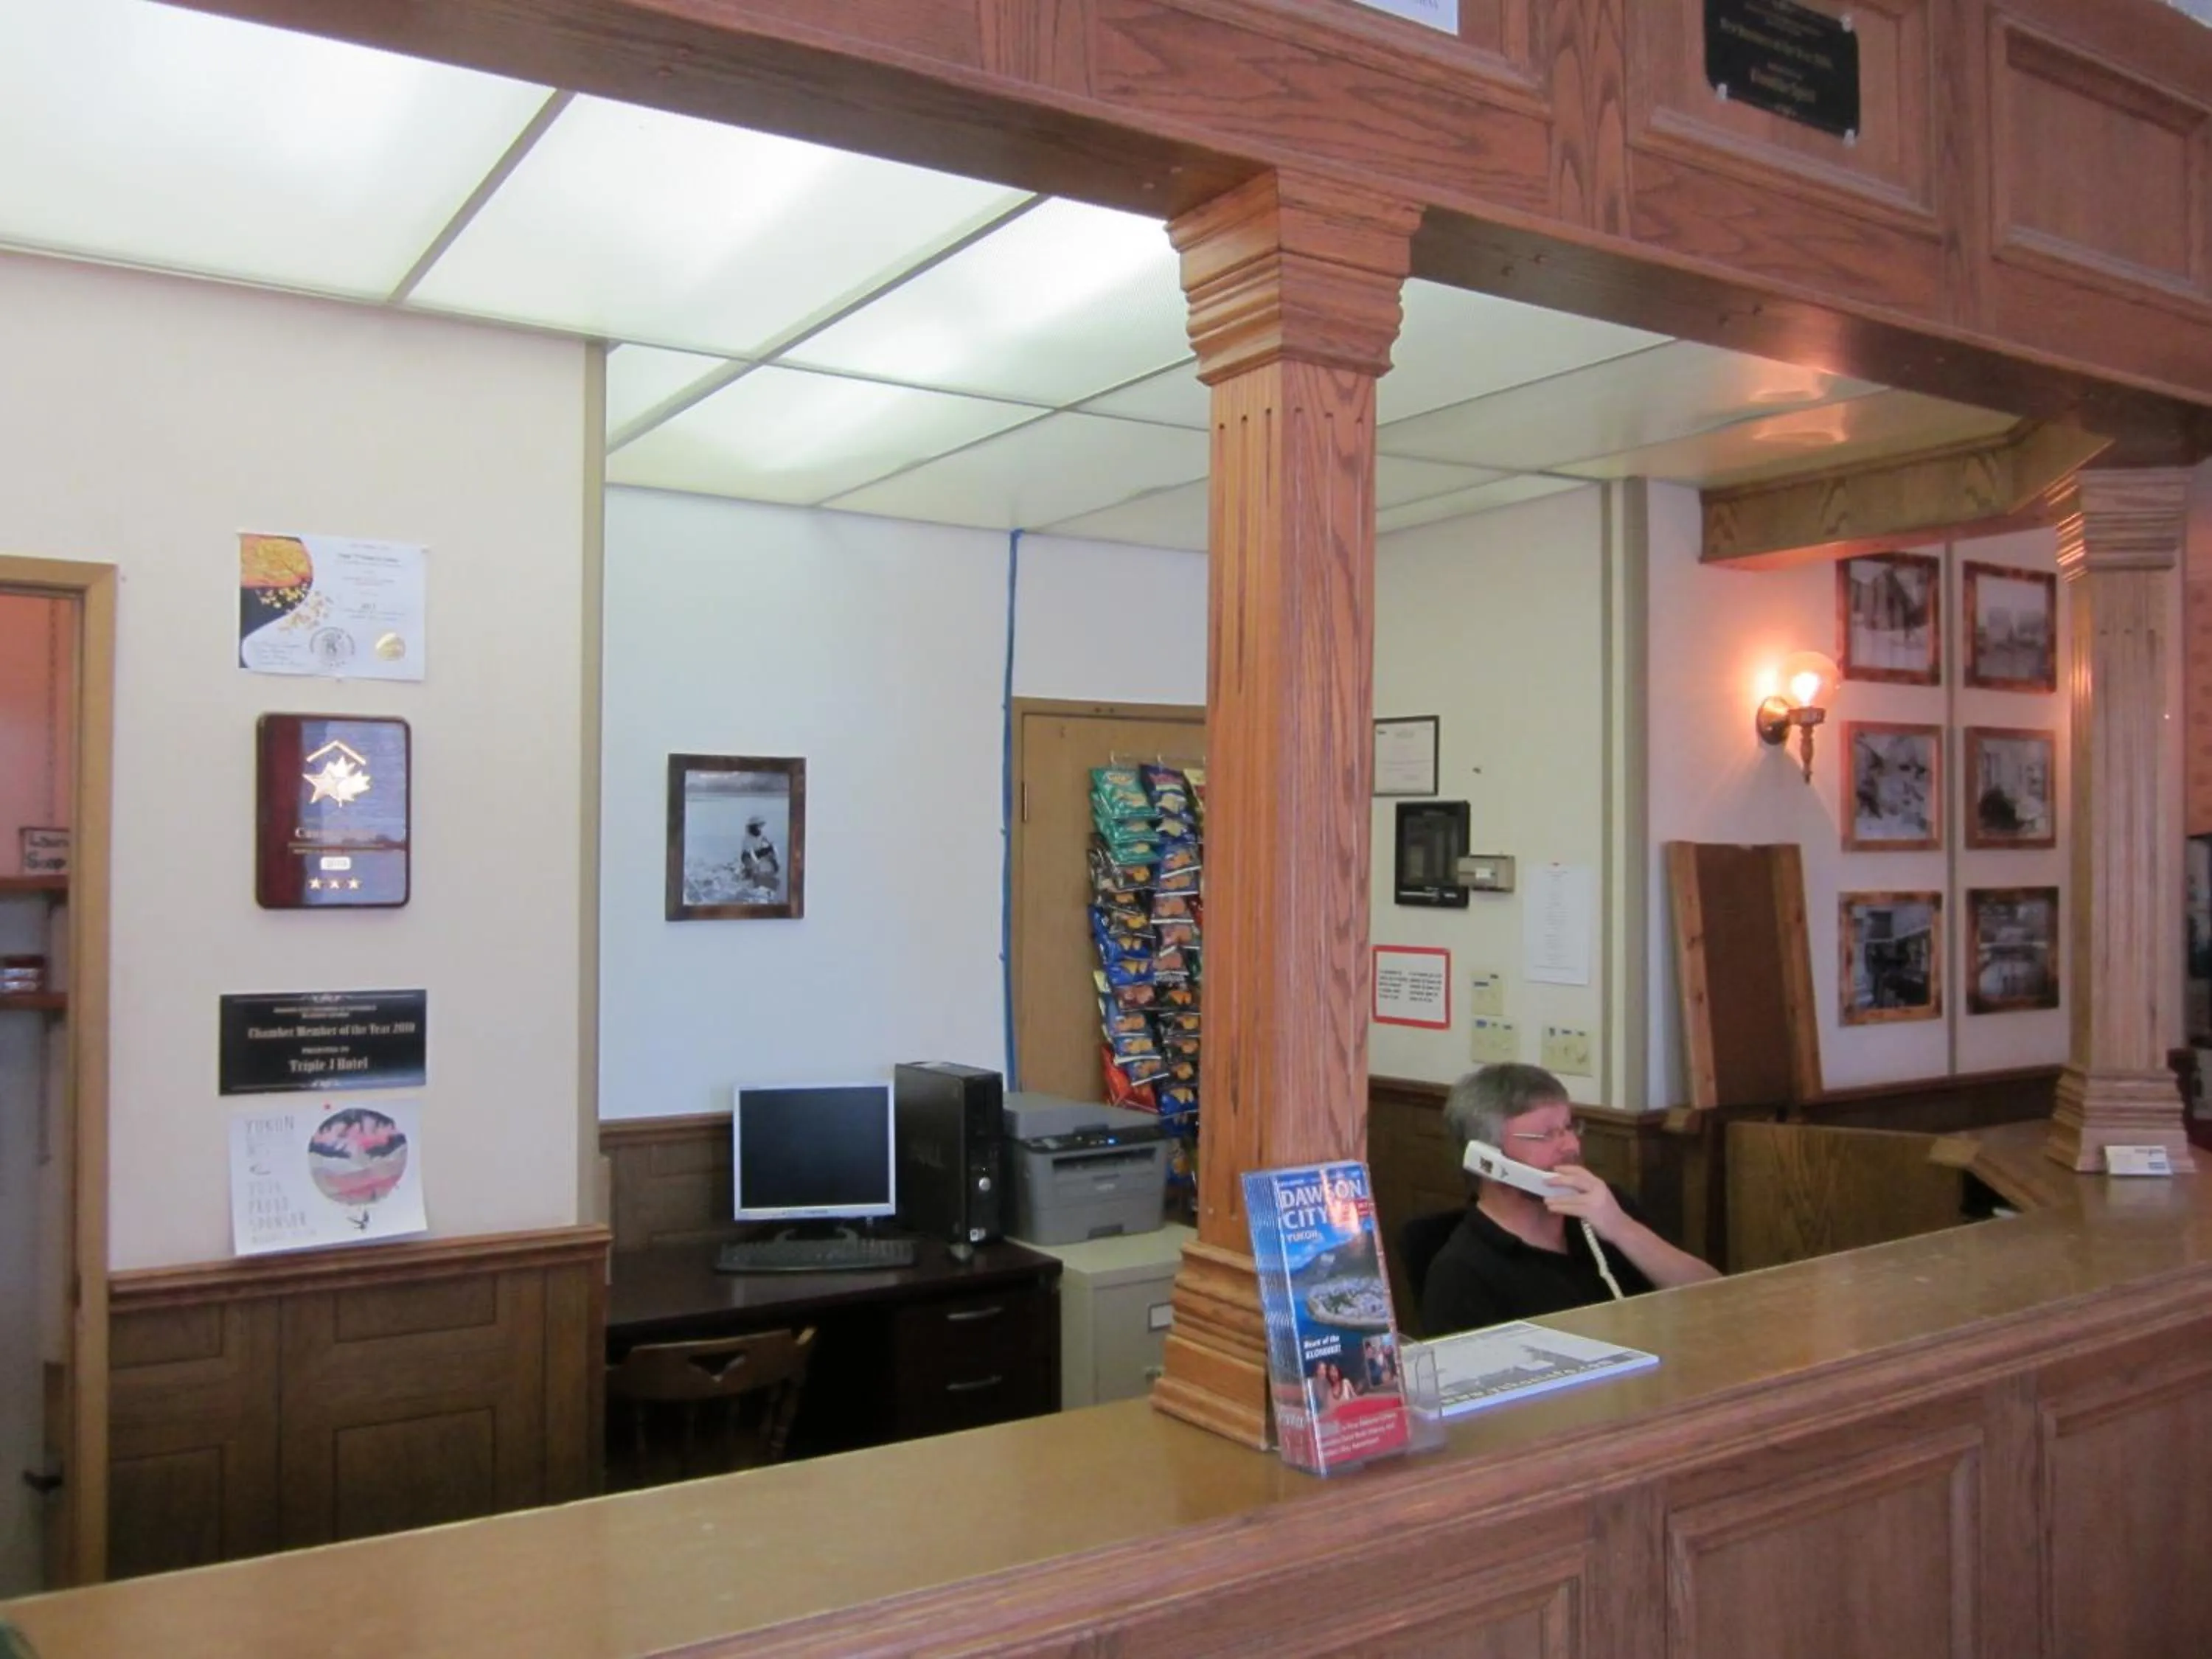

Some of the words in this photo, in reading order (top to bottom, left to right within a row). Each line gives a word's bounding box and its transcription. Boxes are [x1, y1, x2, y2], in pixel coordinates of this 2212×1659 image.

[248, 1026, 294, 1039] Chamber
[296, 1025, 337, 1037] Member
[338, 1024, 349, 1037] of
[351, 1023, 367, 1035] the
[370, 1023, 390, 1035] Year
[289, 1059, 327, 1073] Triple
[330, 1057, 335, 1070] J
[337, 1056, 368, 1070] Hotel
[1279, 1178, 1364, 1209] DAWSON
[1284, 1206, 1330, 1229] CITY
[1287, 1229, 1318, 1242] YUKON
